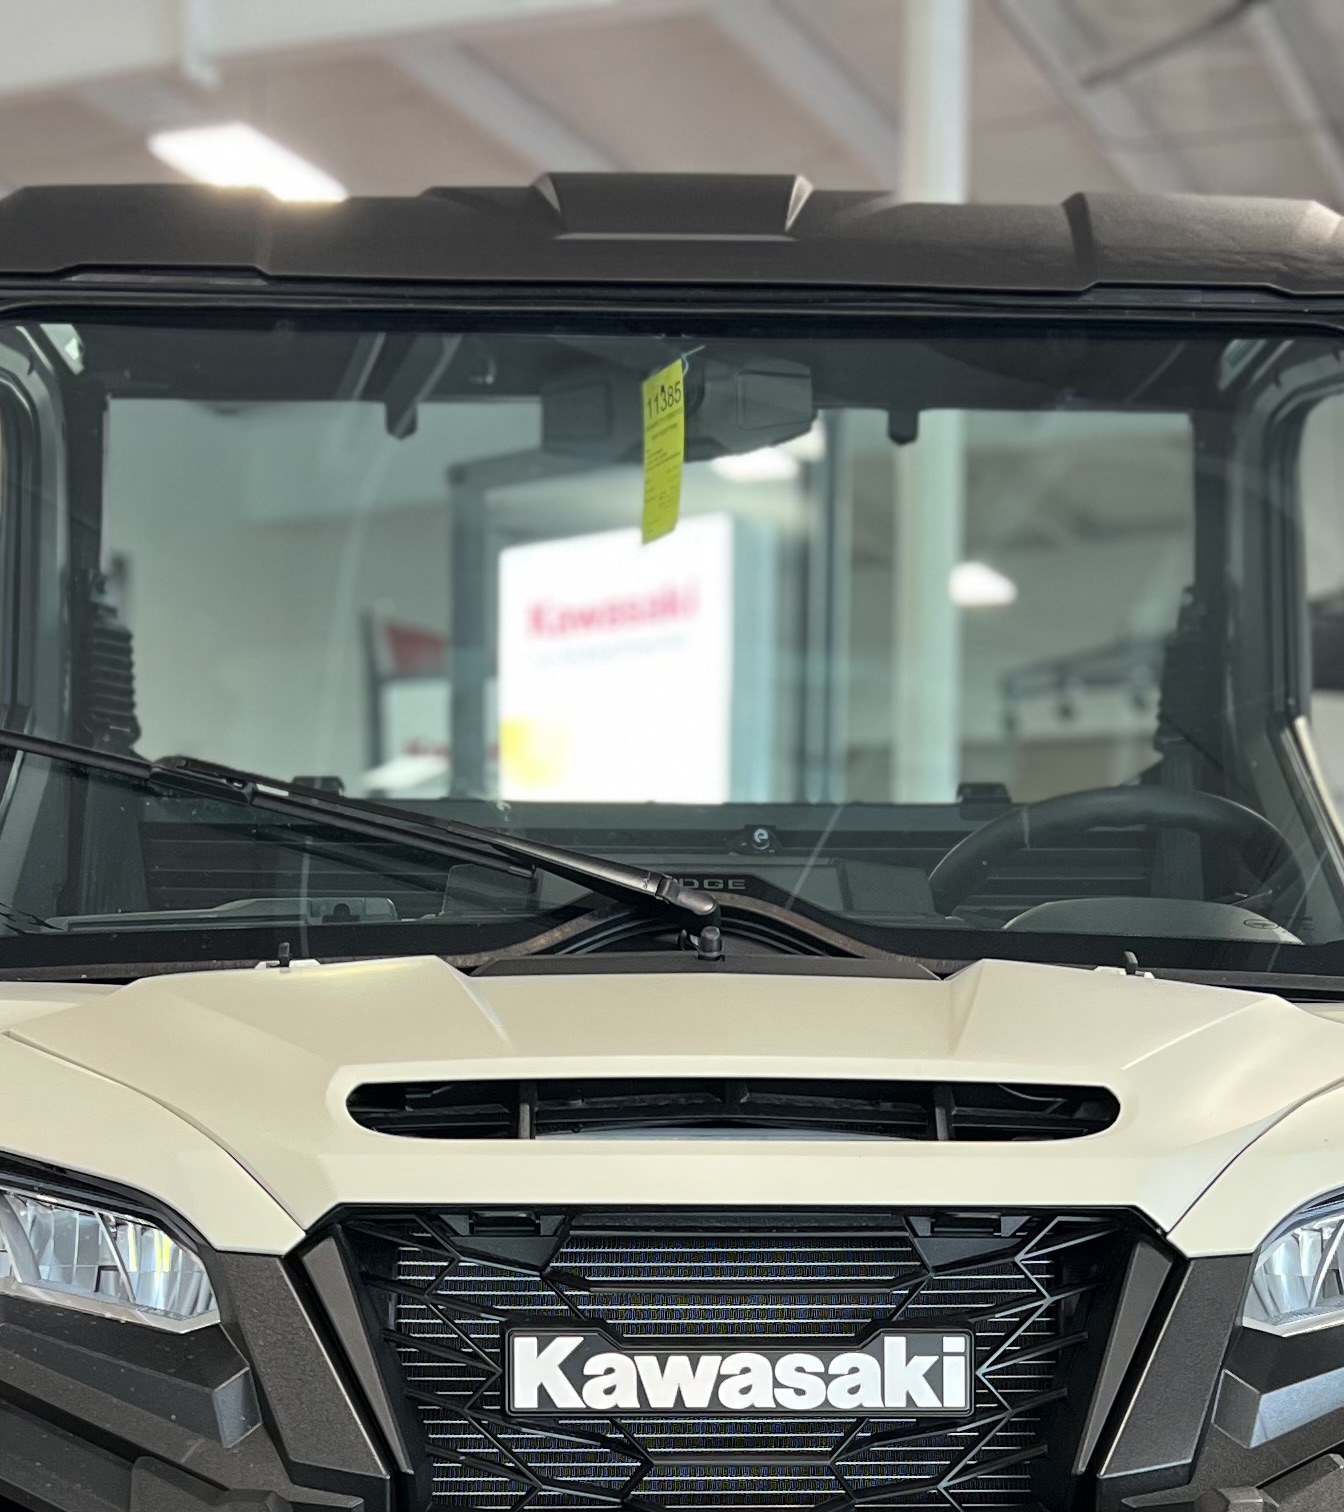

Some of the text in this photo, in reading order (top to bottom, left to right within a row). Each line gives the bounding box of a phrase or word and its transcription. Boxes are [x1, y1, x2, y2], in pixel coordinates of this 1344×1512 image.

[647, 381, 682, 419] 11385
[678, 878, 747, 890] DGE
[513, 1335, 967, 1411] Kawasaki
